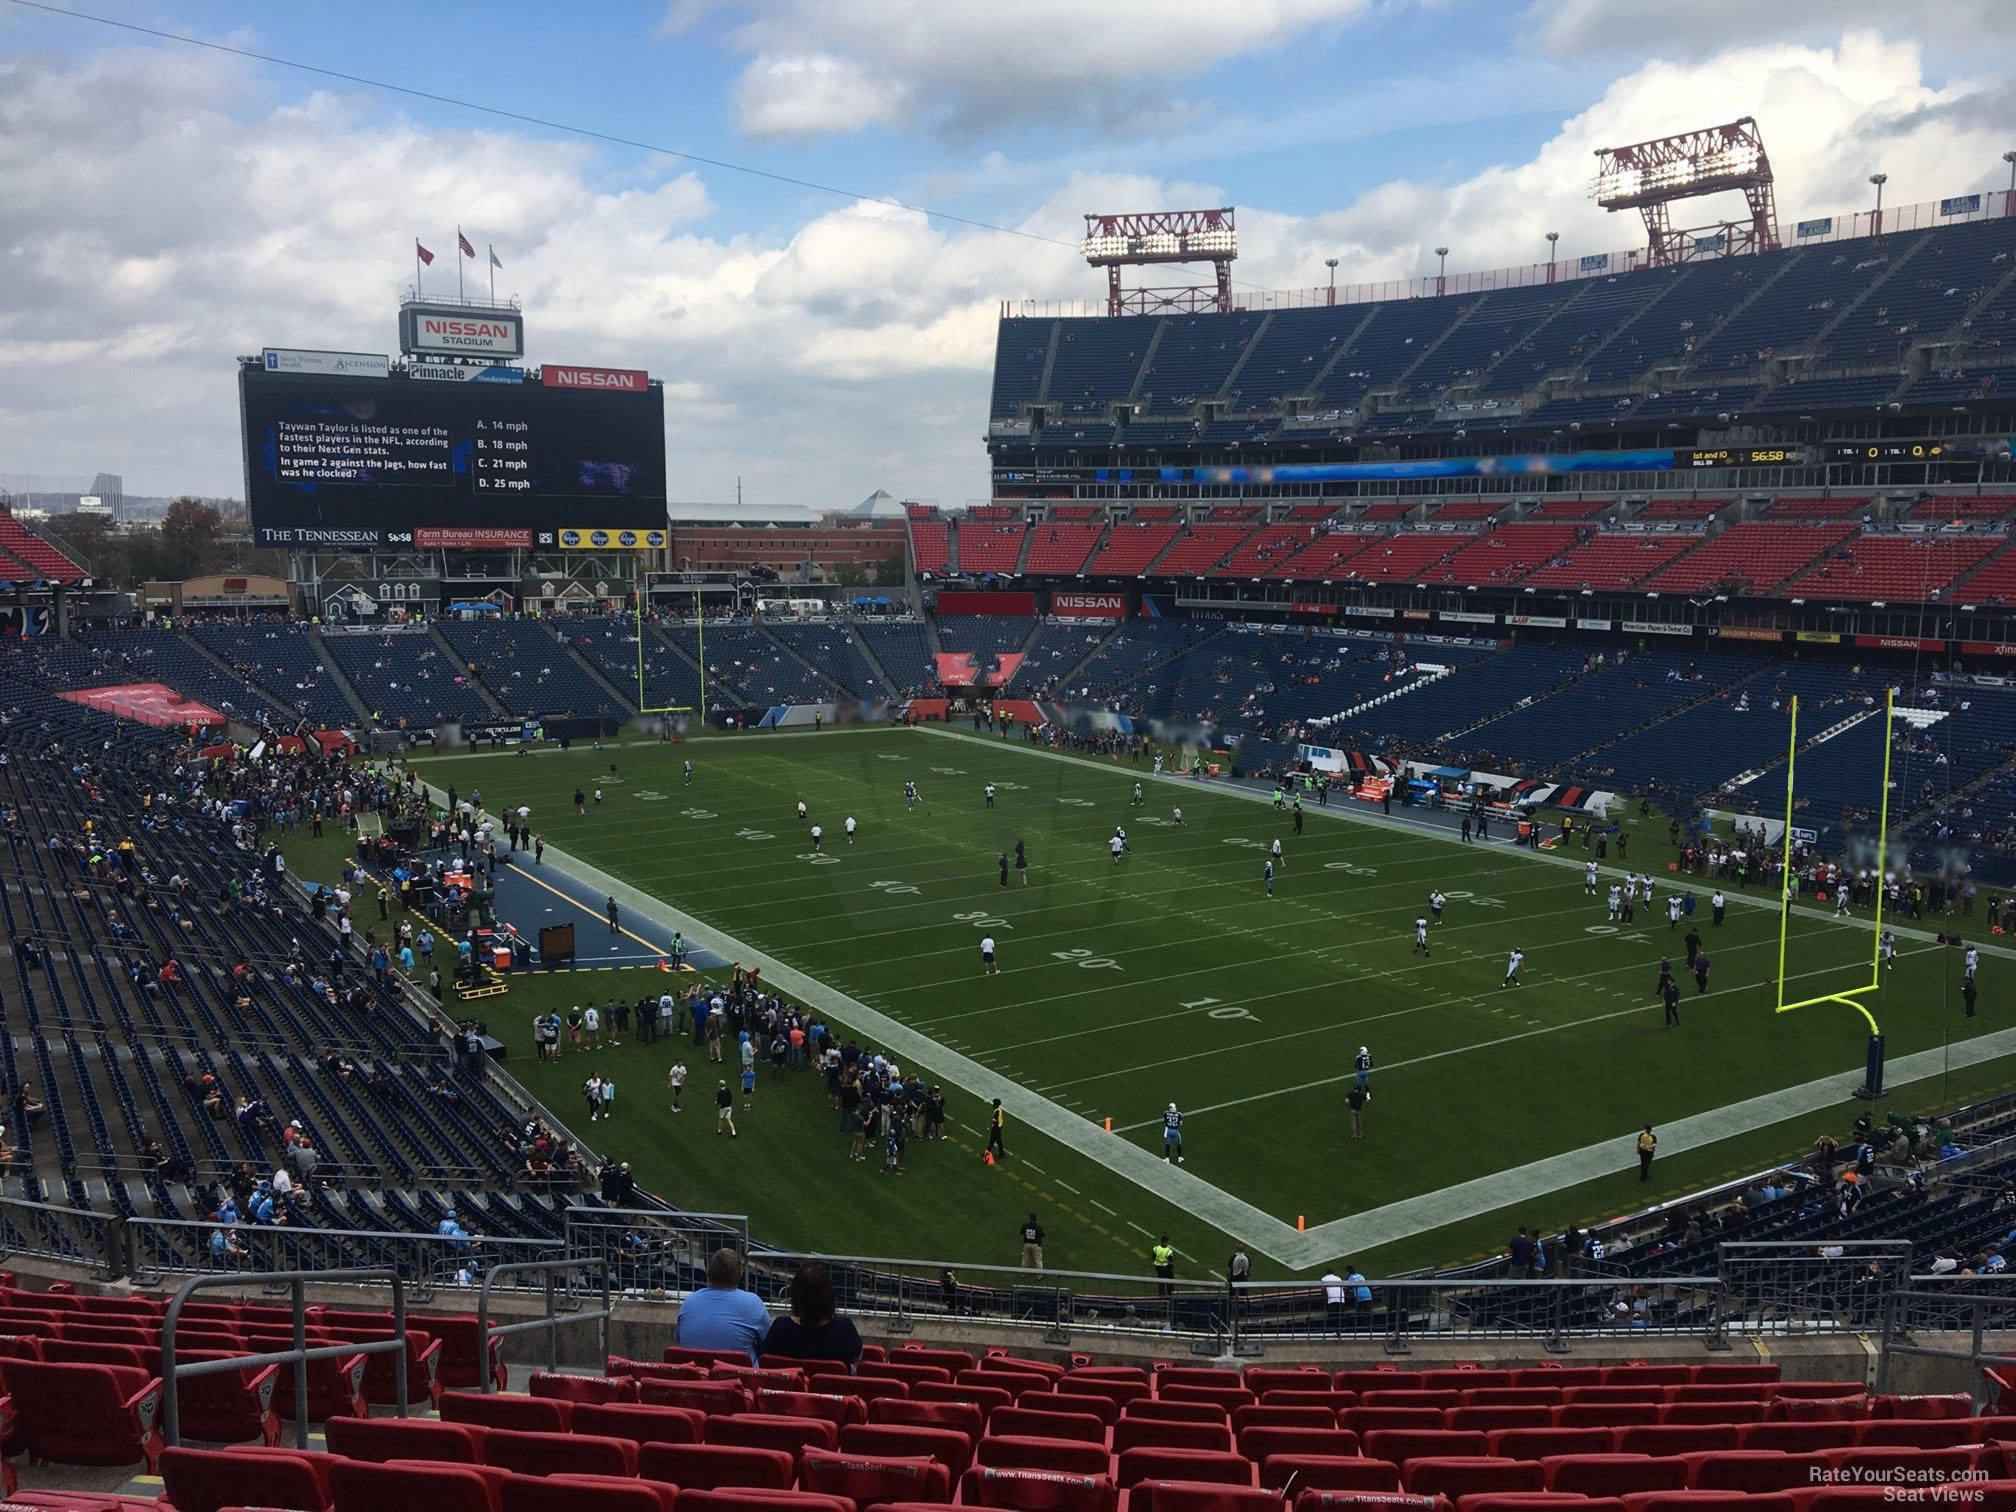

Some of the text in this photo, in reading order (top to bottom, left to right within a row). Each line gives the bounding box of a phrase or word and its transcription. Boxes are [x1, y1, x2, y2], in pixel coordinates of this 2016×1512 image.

[425, 320, 508, 338] NISSAN
[442, 336, 493, 347] STADIUM
[334, 358, 386, 371] ASCENSION
[411, 364, 465, 380] Pinnacle
[557, 371, 634, 387] NISSAN
[278, 421, 316, 432] Taywan
[318, 423, 349, 434] Taylor
[351, 424, 359, 433] is
[361, 424, 387, 434] listed
[421, 427, 431, 435] of
[433, 427, 448, 436] the
[476, 420, 528, 432] A. 14 mph
[279, 432, 449, 449] fastest players in the NFL, according
[477, 439, 528, 452] B. 18 mph
[280, 444, 390, 455] to their Next Gen stats.
[1704, 451, 1718, 459] and
[1751, 450, 1784, 462] 56:58
[280, 457, 448, 471] In game 2 against the Jags, how fast
[478, 458, 528, 471] C. 21 mph
[281, 468, 358, 478] was he clocked?
[479, 478, 530, 491] D. 25 mph
[262, 528, 379, 541] THE TENNESSEAN
[388, 533, 412, 542] 56:58
[417, 529, 529, 539] Farm Bureau INSURANCE
[1056, 596, 1121, 609] NISSAN
[1750, 631, 1781, 640] PRODUCTS
[1880, 638, 1918, 649] NISSAN
[1800, 832, 1814, 840] NFL
[868, 880, 919, 894] 40
[953, 911, 1010, 929] 30
[1051, 949, 1117, 969] 20
[1179, 997, 1252, 1021] 10
[1166, 1116, 1178, 1127] 32
[995, 1470, 1085, 1488] www.TitansSeats.com
